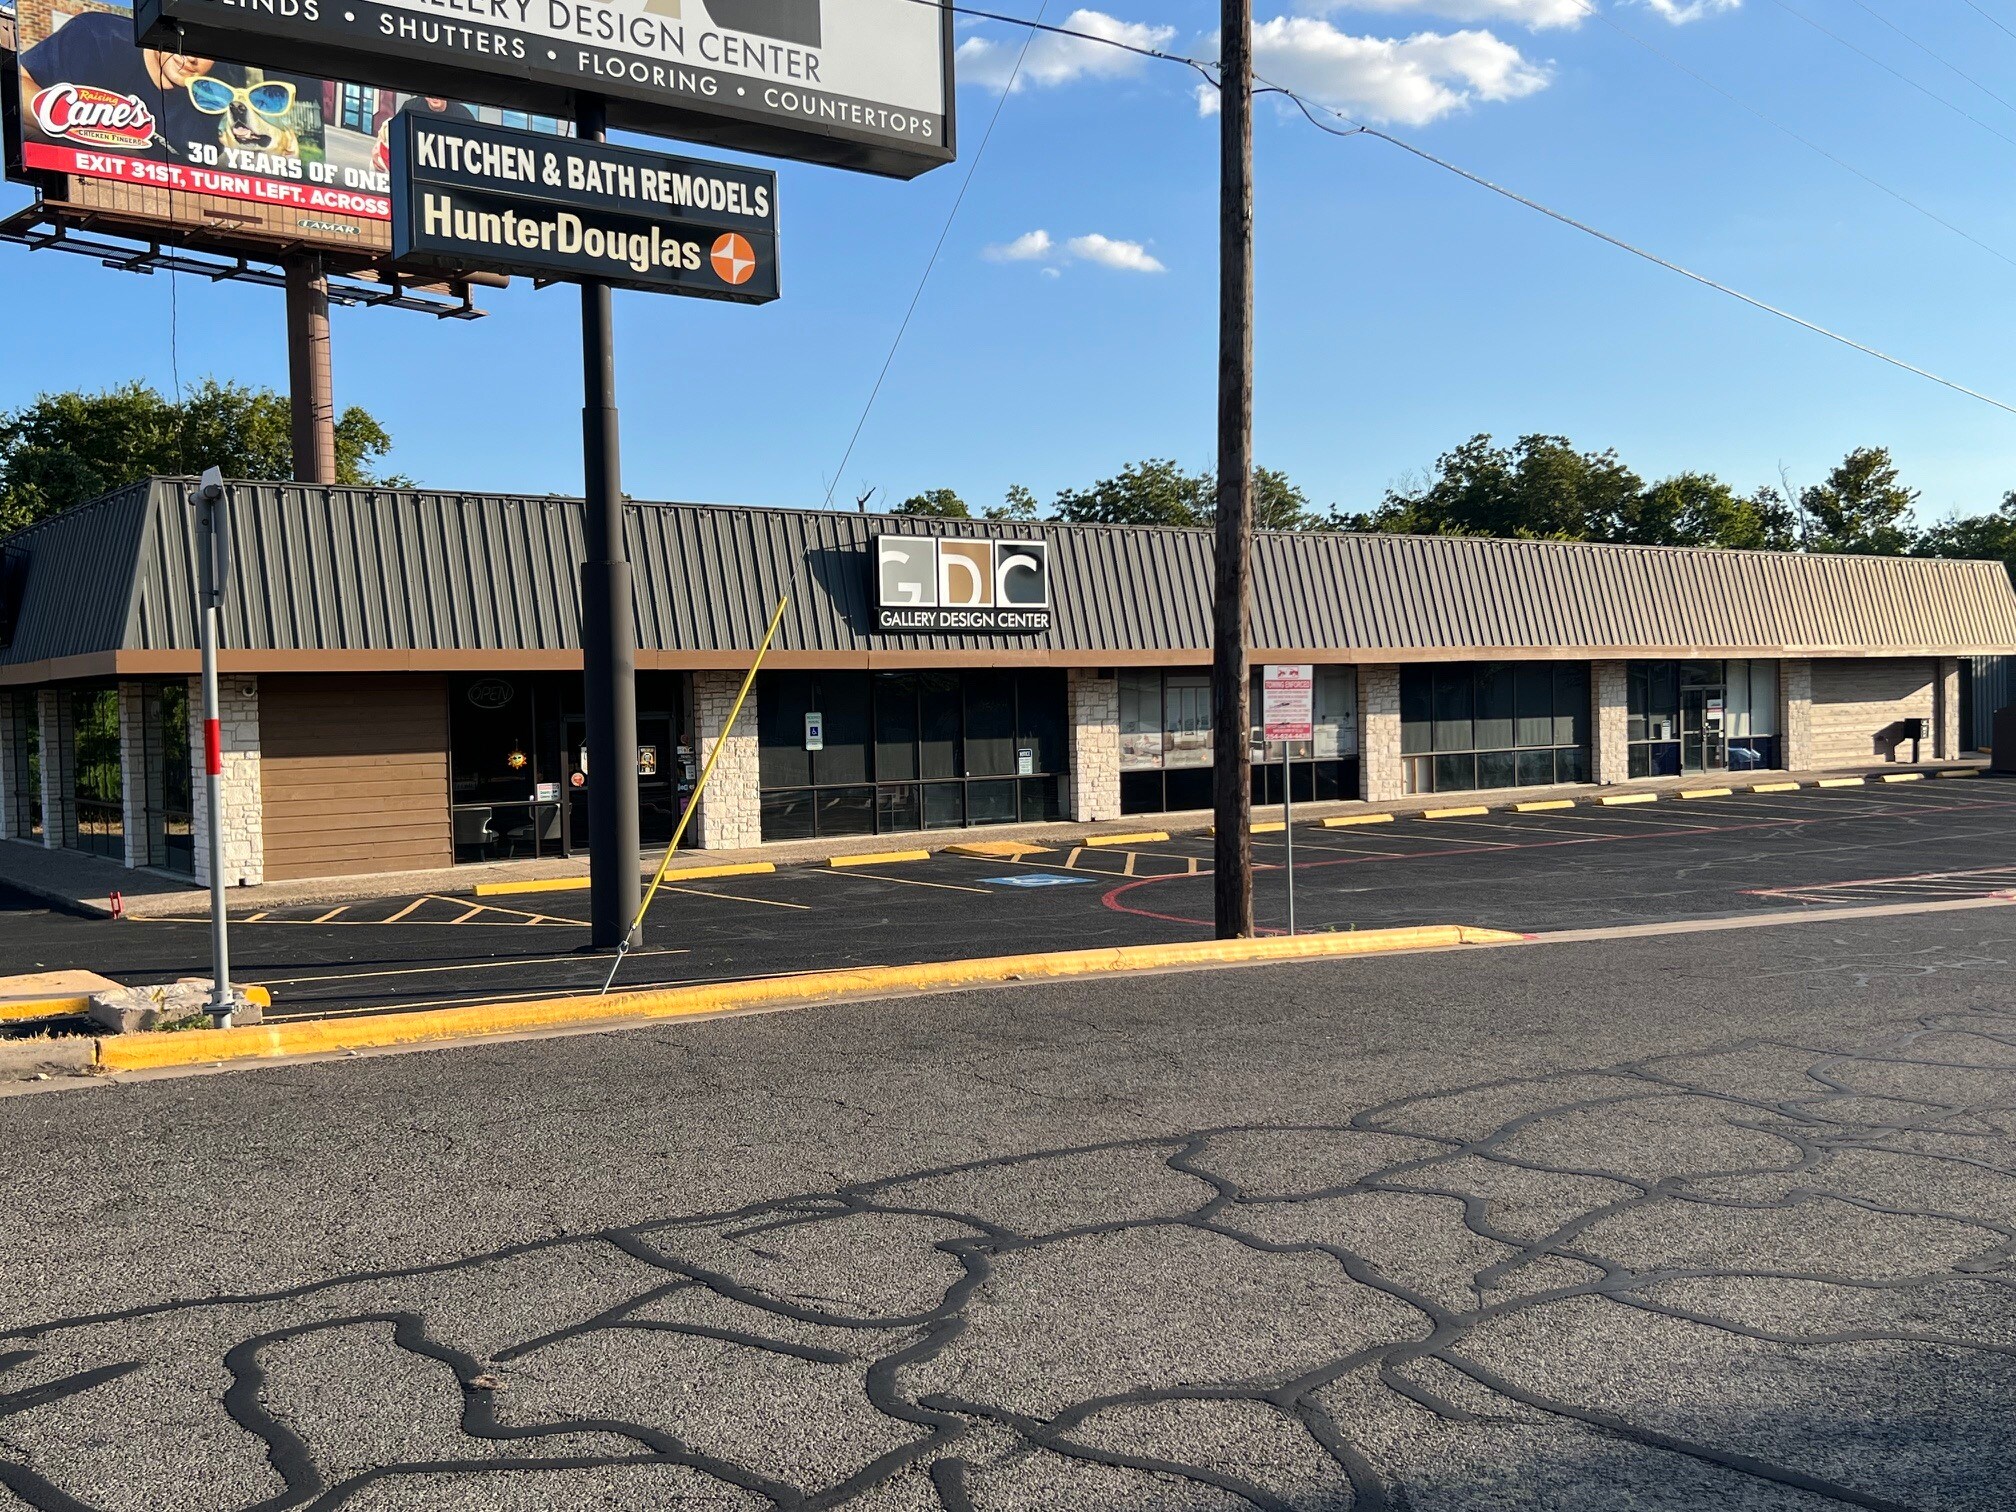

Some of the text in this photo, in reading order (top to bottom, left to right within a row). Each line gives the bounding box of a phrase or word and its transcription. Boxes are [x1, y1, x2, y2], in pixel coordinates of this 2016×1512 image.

[549, 0, 685, 57] DESIGN
[699, 32, 822, 83] CENTER
[223, 0, 933, 139] NDS SHUTTERS FLOORING COUNTERTOPS
[39, 84, 153, 133] Cane's
[80, 90, 118, 106] Raising
[76, 152, 390, 216] EXIT 31ST, TURN LEFT. ACROSS
[188, 141, 390, 193] 30 YEARS OF ONE
[417, 131, 770, 220] KITCHEN & BATH REMODELS
[302, 220, 355, 234] LAMAR
[423, 193, 702, 273] HunterDouglas
[880, 549, 1038, 607] GDC
[880, 611, 1049, 628] GALLERY DESIGN CENTER
[1285, 680, 1310, 688] ENFORCED
